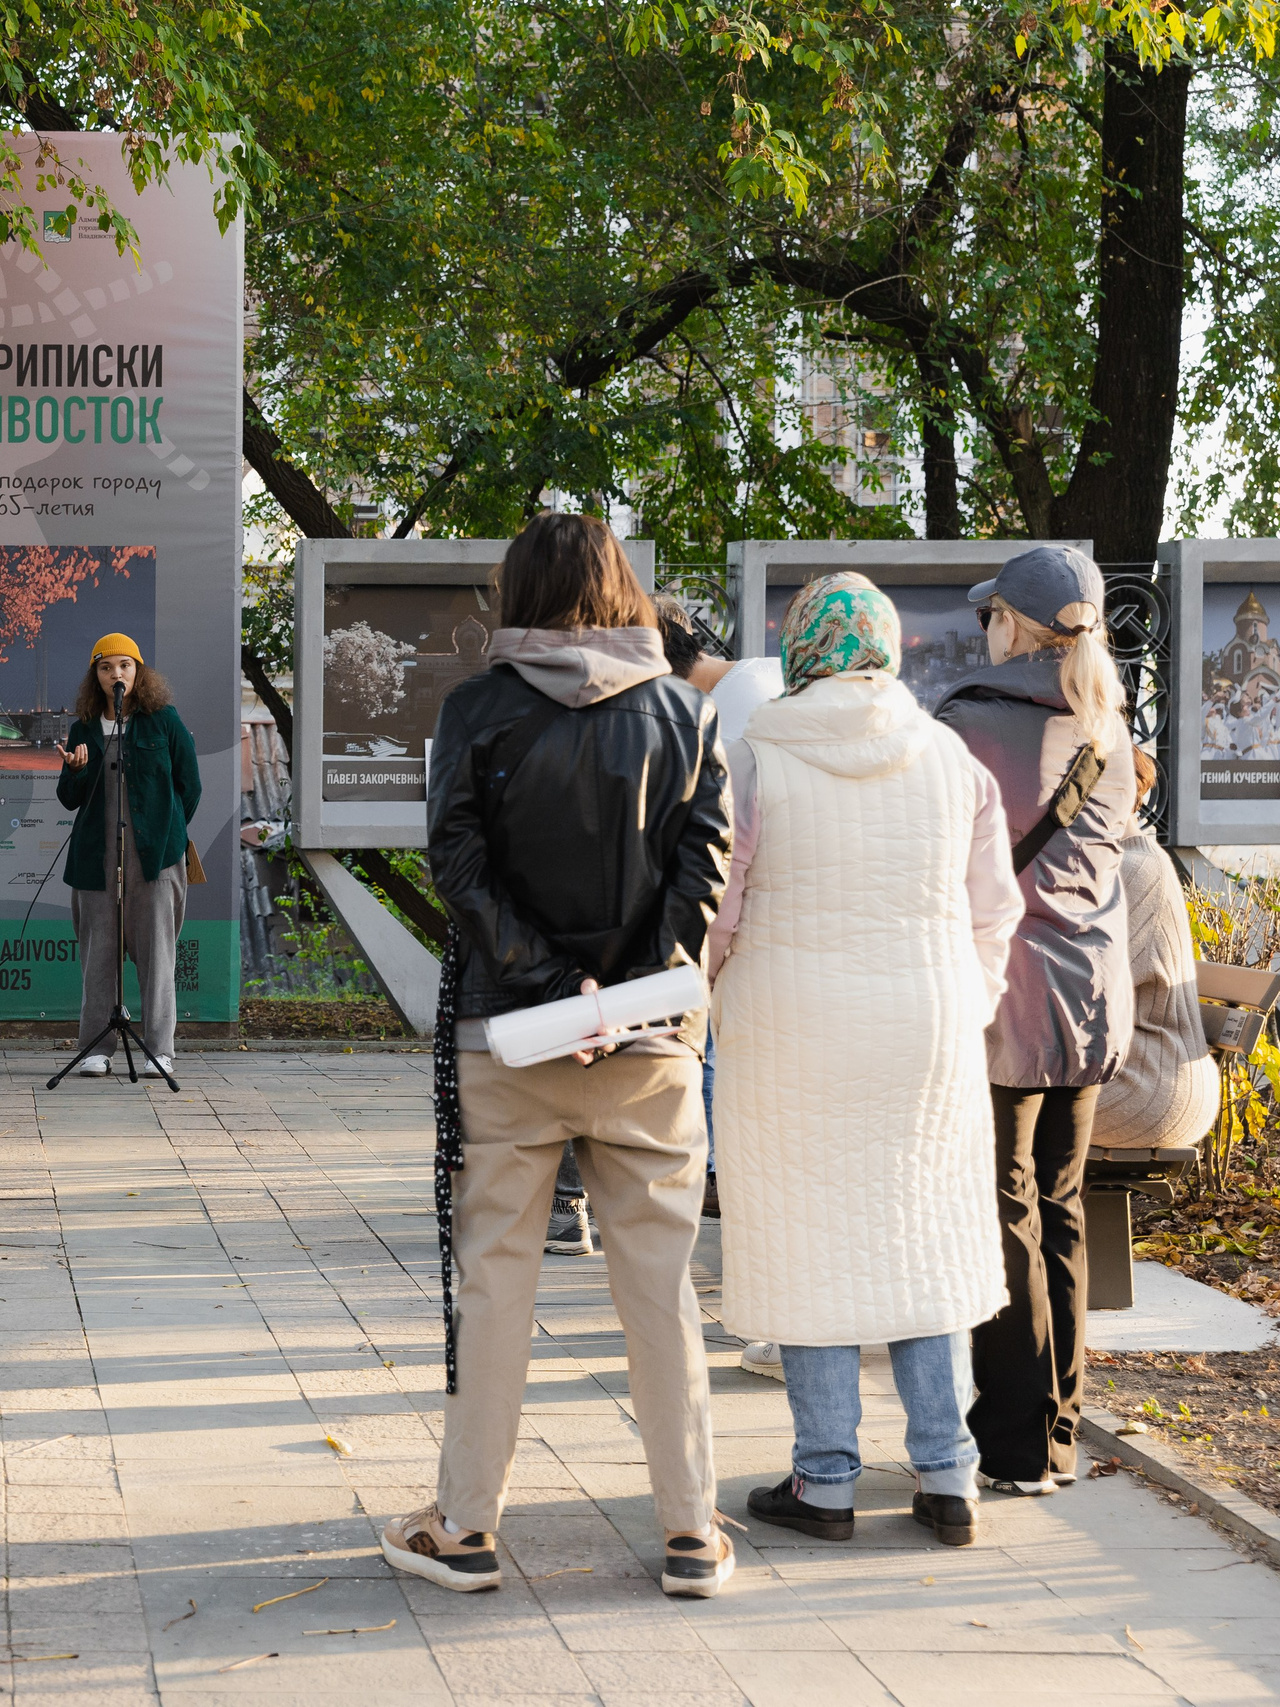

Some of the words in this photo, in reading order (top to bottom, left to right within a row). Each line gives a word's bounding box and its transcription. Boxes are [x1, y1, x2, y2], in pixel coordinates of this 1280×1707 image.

[0, 477, 83, 496] подарок
[93, 477, 161, 500] городу
[327, 773, 358, 785] ПАВЕЛ
[1200, 769, 1231, 784] ГЕНИЙ
[1233, 771, 1280, 784] КУЧЕРЕНК
